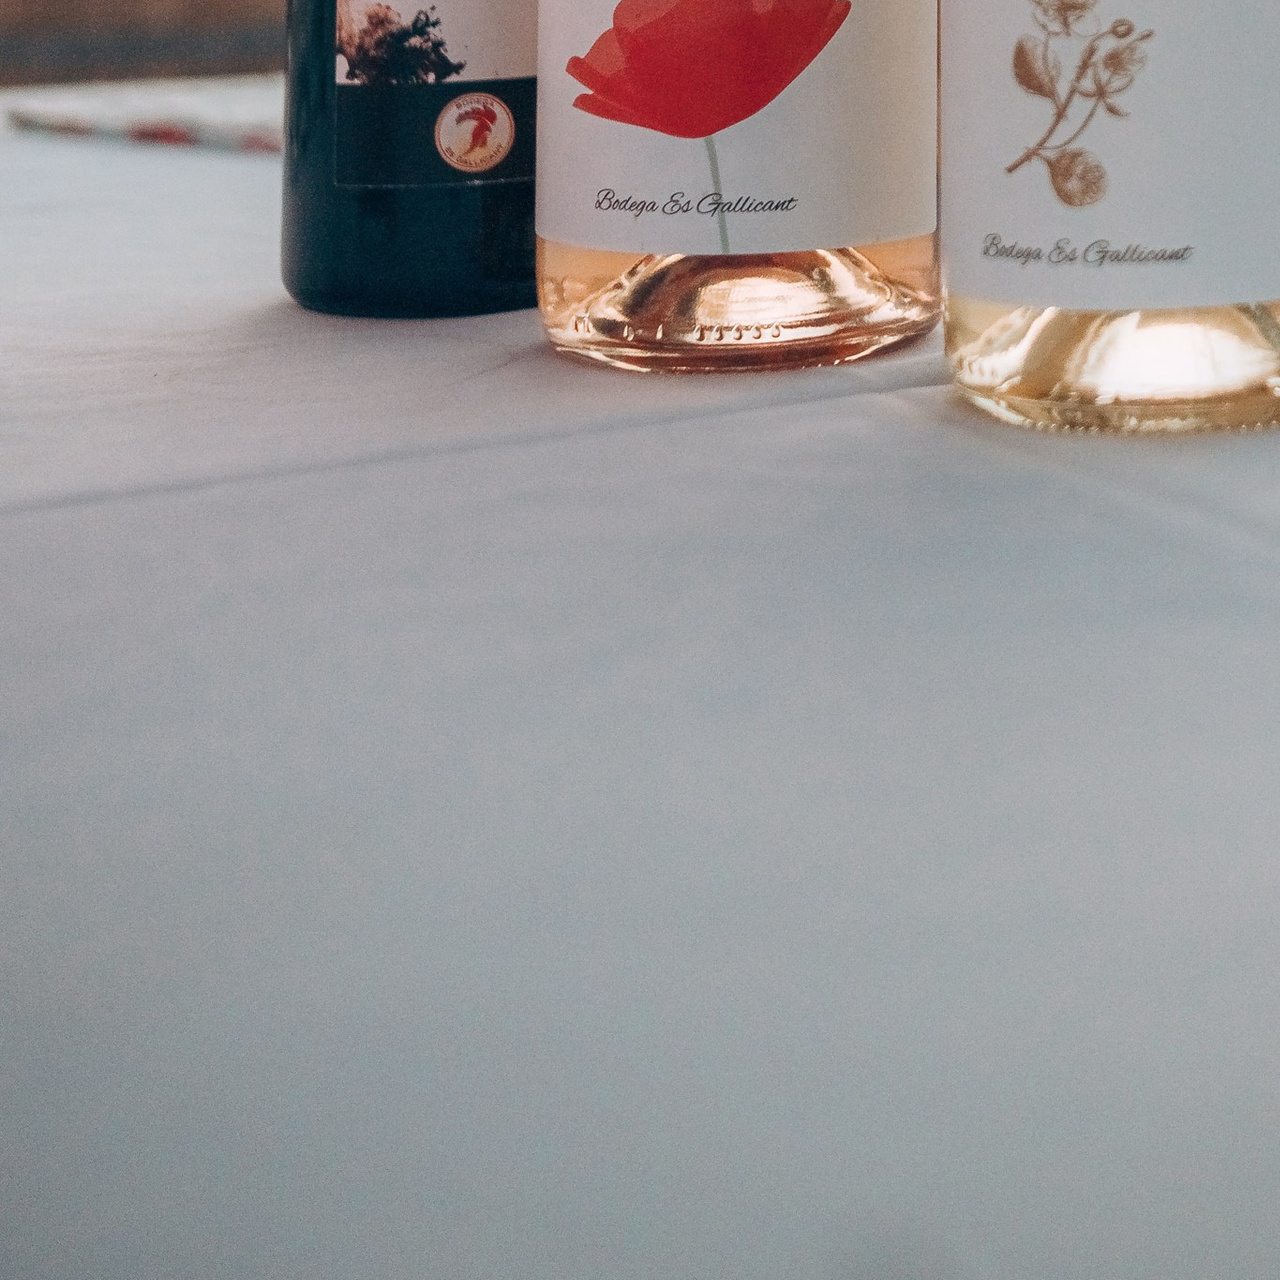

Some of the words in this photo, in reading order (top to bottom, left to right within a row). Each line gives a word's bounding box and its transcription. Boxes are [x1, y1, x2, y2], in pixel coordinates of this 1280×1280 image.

[594, 188, 658, 218] Bodega
[661, 191, 692, 215] Es
[696, 192, 799, 218] Gallicant
[982, 232, 1043, 266] Bodega
[1048, 237, 1078, 264] Es
[1083, 238, 1195, 267] Gallicant
